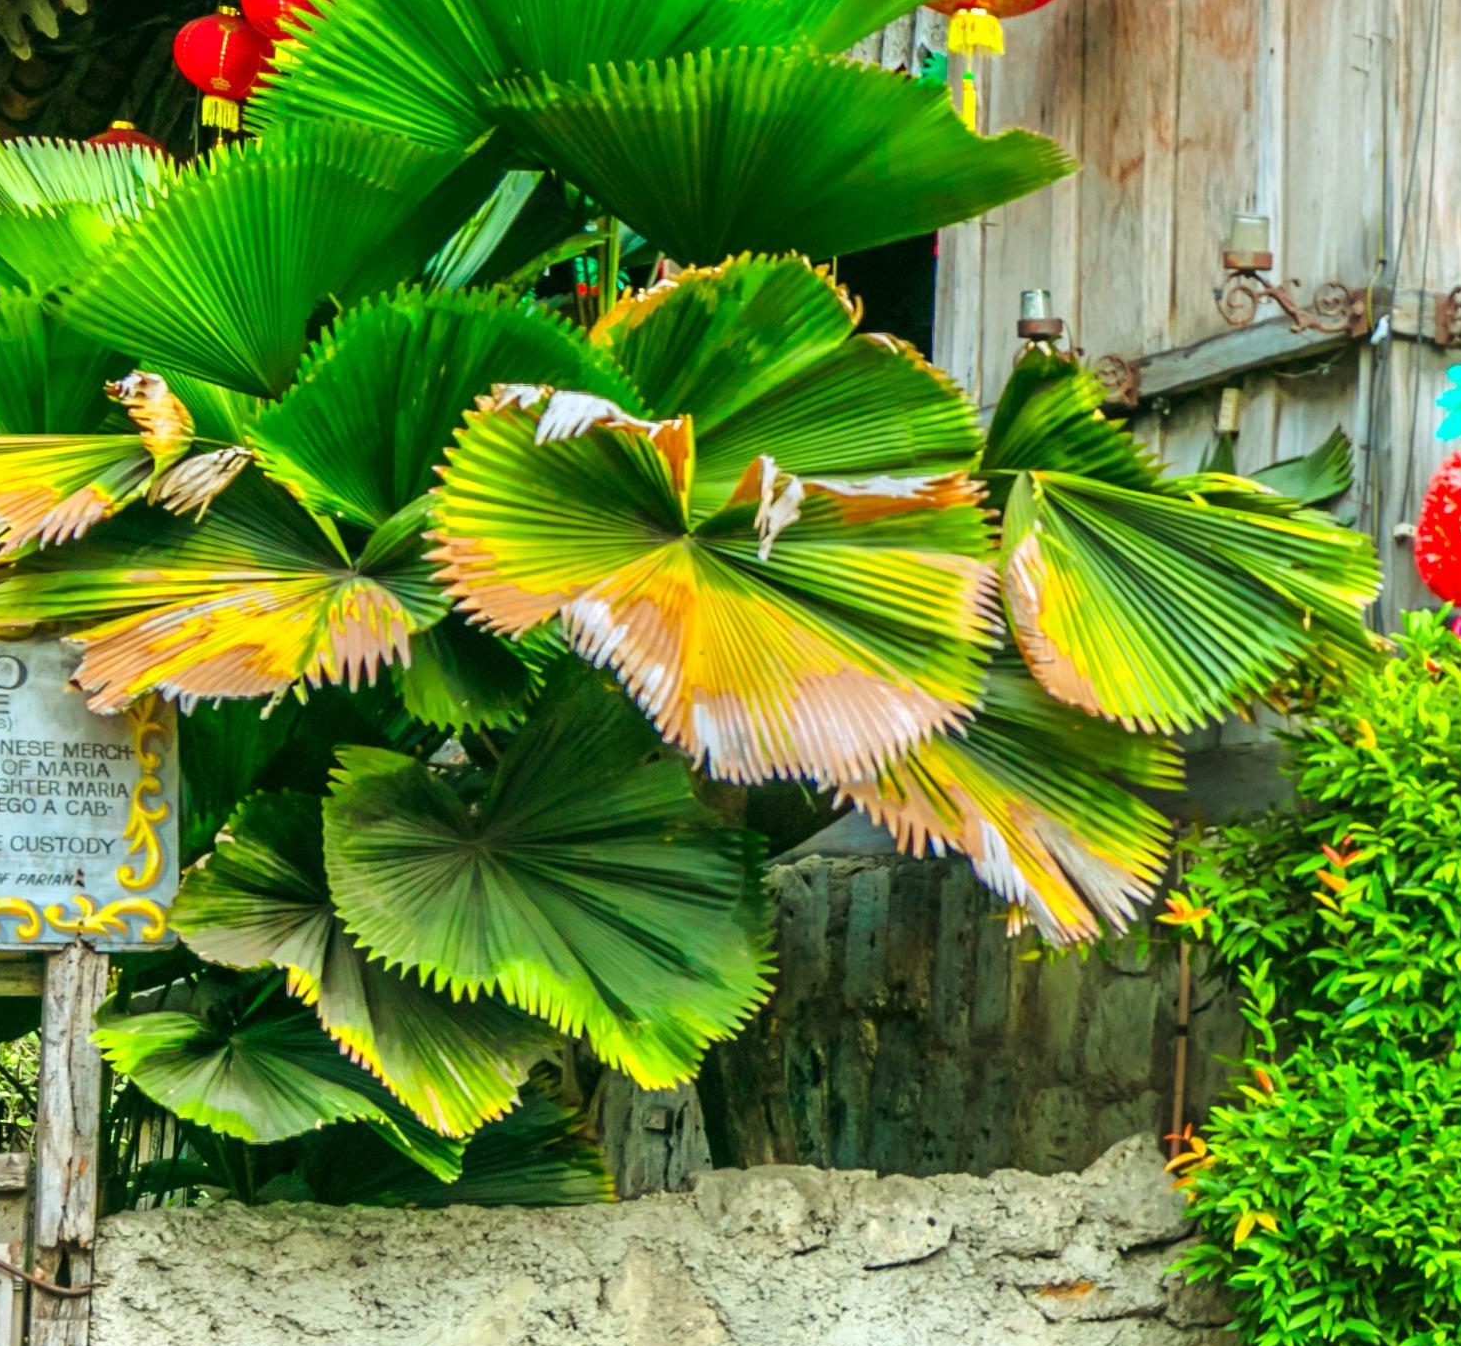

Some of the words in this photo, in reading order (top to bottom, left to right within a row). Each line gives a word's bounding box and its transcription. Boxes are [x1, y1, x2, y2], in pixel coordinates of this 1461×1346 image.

[1, 757, 31, 775] OF
[37, 759, 111, 778] MARIA
[67, 780, 130, 799] MARIA
[42, 797, 59, 814] A
[65, 799, 114, 817] CAB-
[9, 835, 117, 855] CUSTODY
